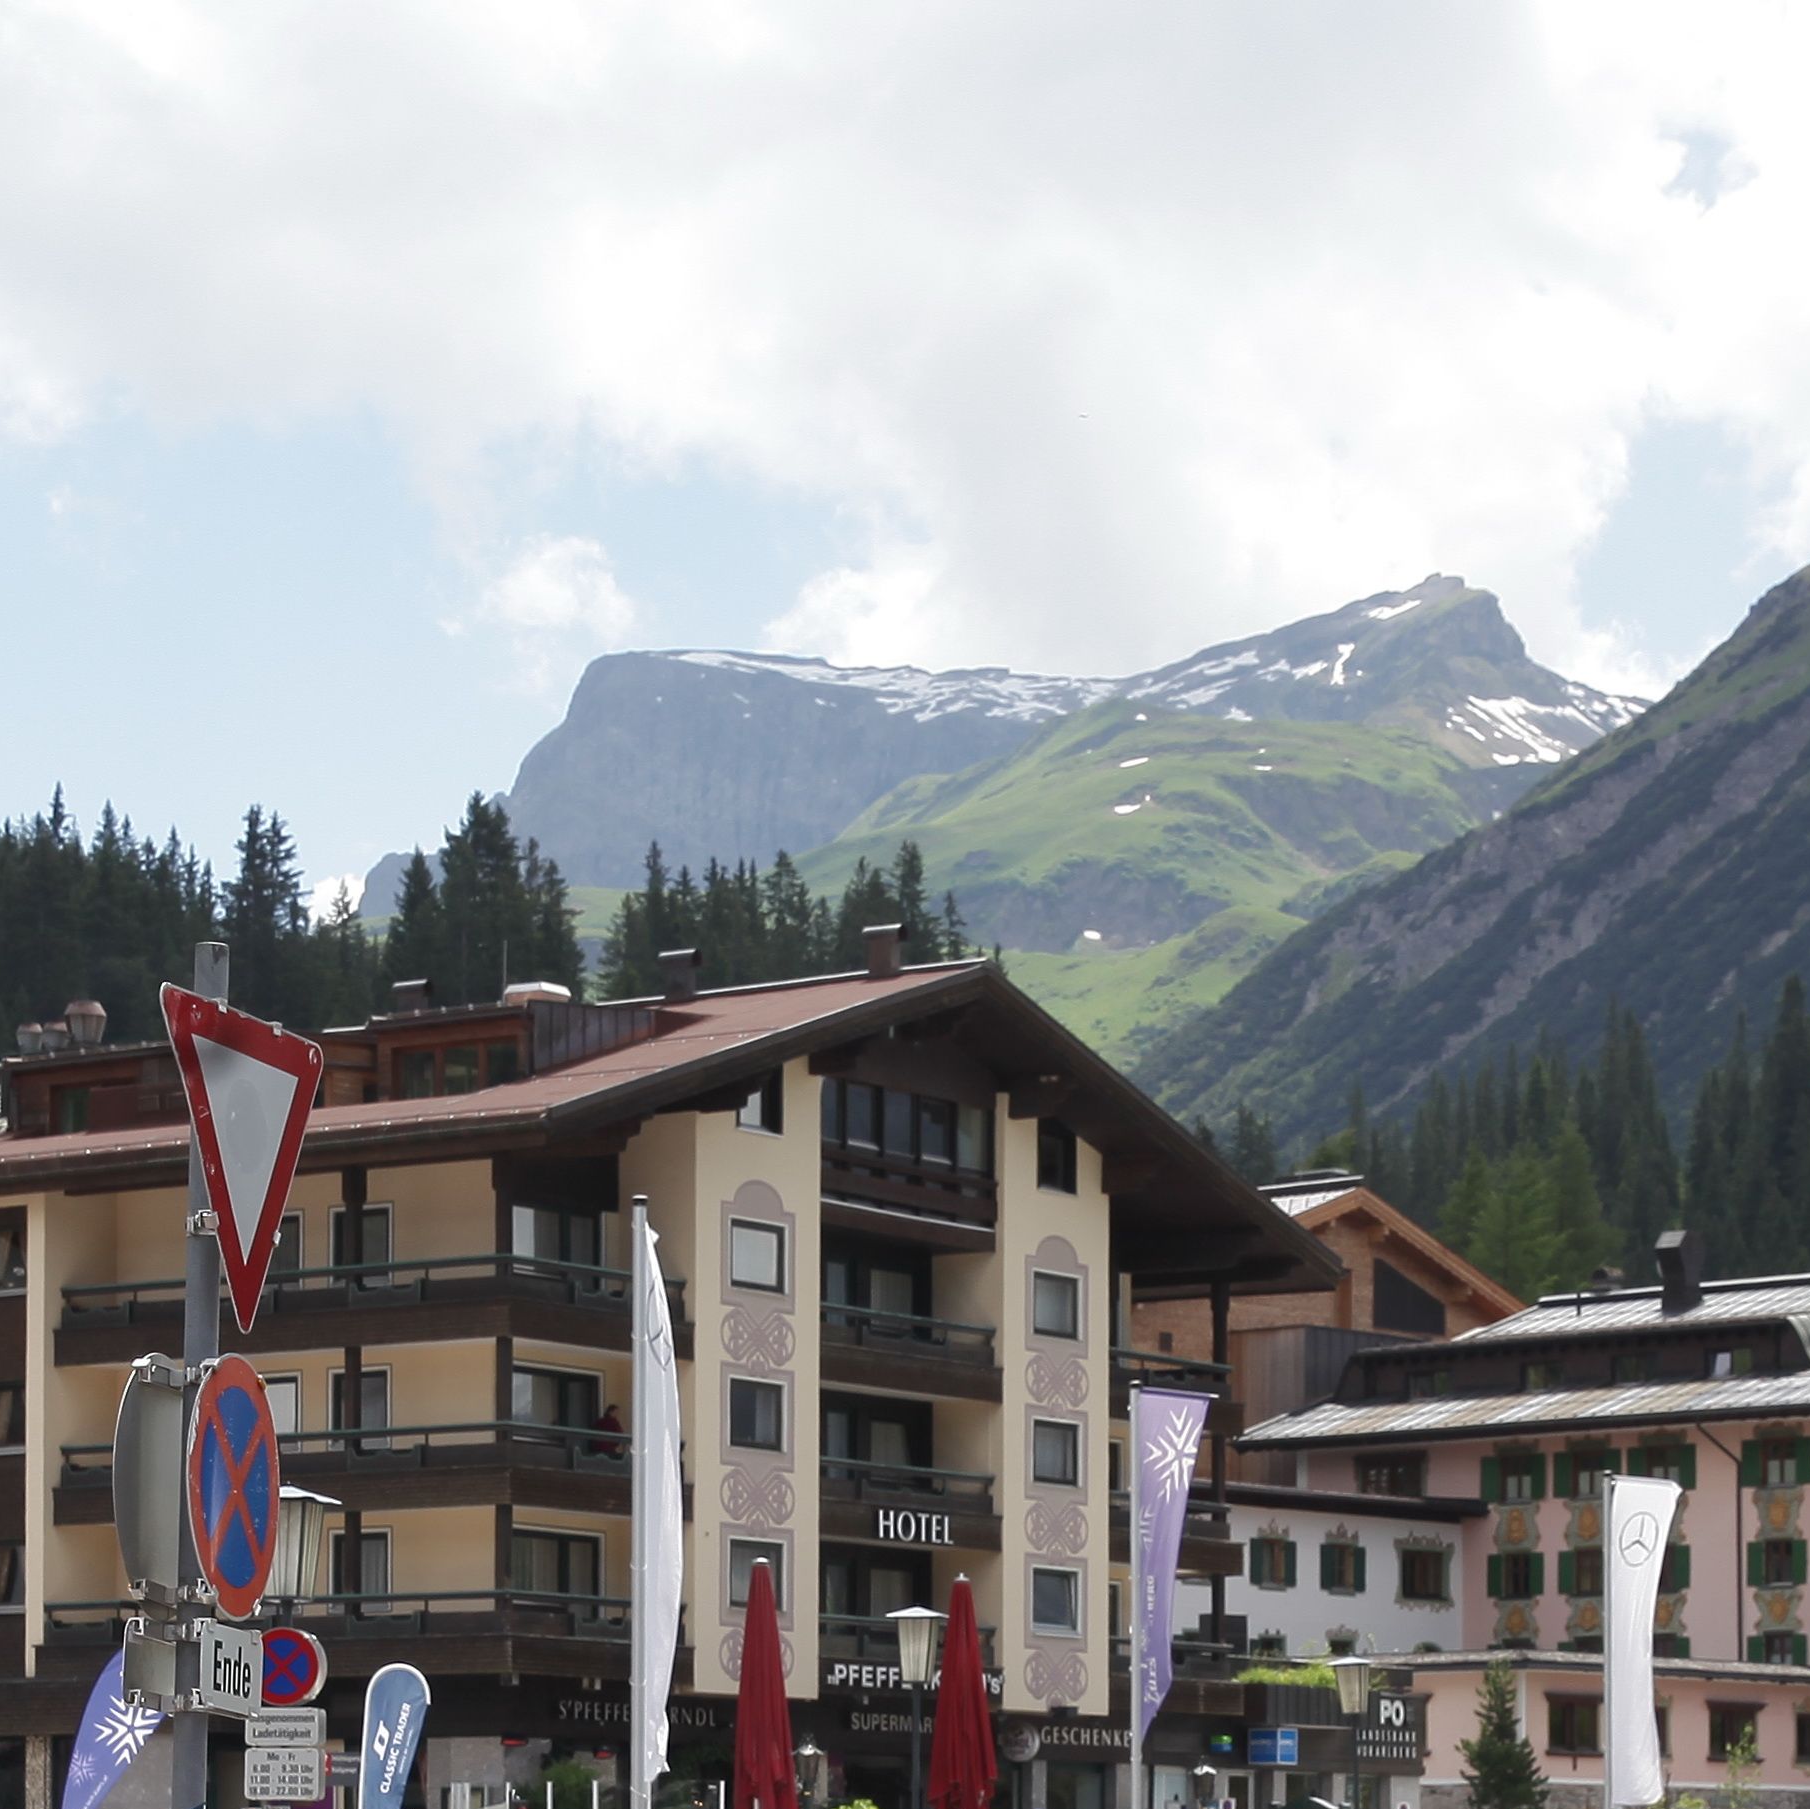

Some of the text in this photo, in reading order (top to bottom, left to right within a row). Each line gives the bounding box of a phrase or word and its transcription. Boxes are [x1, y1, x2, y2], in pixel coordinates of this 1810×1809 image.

[878, 1509, 954, 1545] HOTEL
[213, 1639, 251, 1699] Ende
[253, 1727, 311, 1740] Ladetätigkeit
[1040, 1725, 1130, 1748] GESCHENKE
[380, 1747, 400, 1793] CLASSIC
[393, 1702, 411, 1745] TRADER
[267, 1752, 279, 1761] Mo
[288, 1752, 296, 1761] Fr
[301, 1764, 314, 1774] Uhr
[301, 1776, 314, 1785] Uhr
[301, 1787, 314, 1796] Uhr
